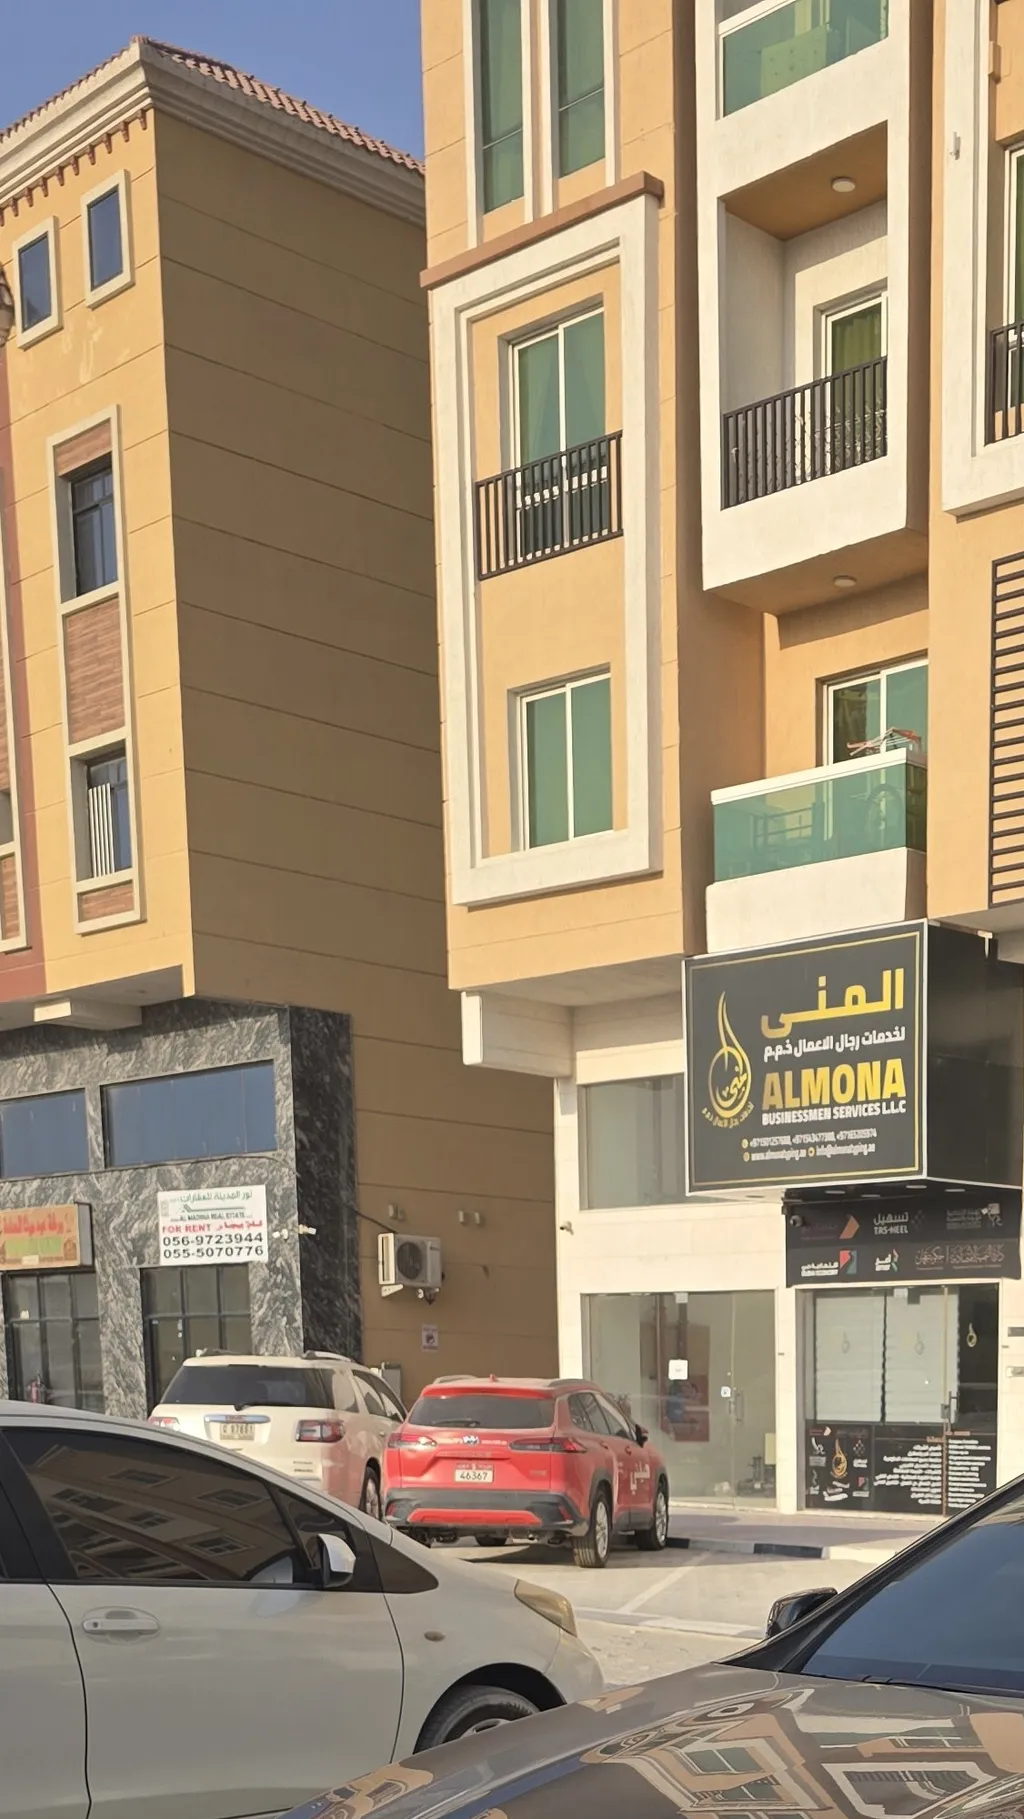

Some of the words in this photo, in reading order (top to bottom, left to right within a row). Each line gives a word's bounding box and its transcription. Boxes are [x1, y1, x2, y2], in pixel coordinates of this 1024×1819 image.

[761, 967, 905, 1039] المنى
[835, 1034, 860, 1053] رجال
[860, 1026, 906, 1046] لخدمات
[762, 1058, 907, 1111] ALMONA
[762, 1107, 832, 1126] BUSINESSMEN
[833, 1102, 881, 1120] SERVICES
[873, 1211, 909, 1226] تسهيل
[162, 1225, 182, 1233] FOR
[185, 1223, 211, 1233] RENT
[162, 1232, 263, 1247] 056-9723944
[163, 1245, 264, 1259] 055-5070776
[459, 1471, 489, 1481] 46367
